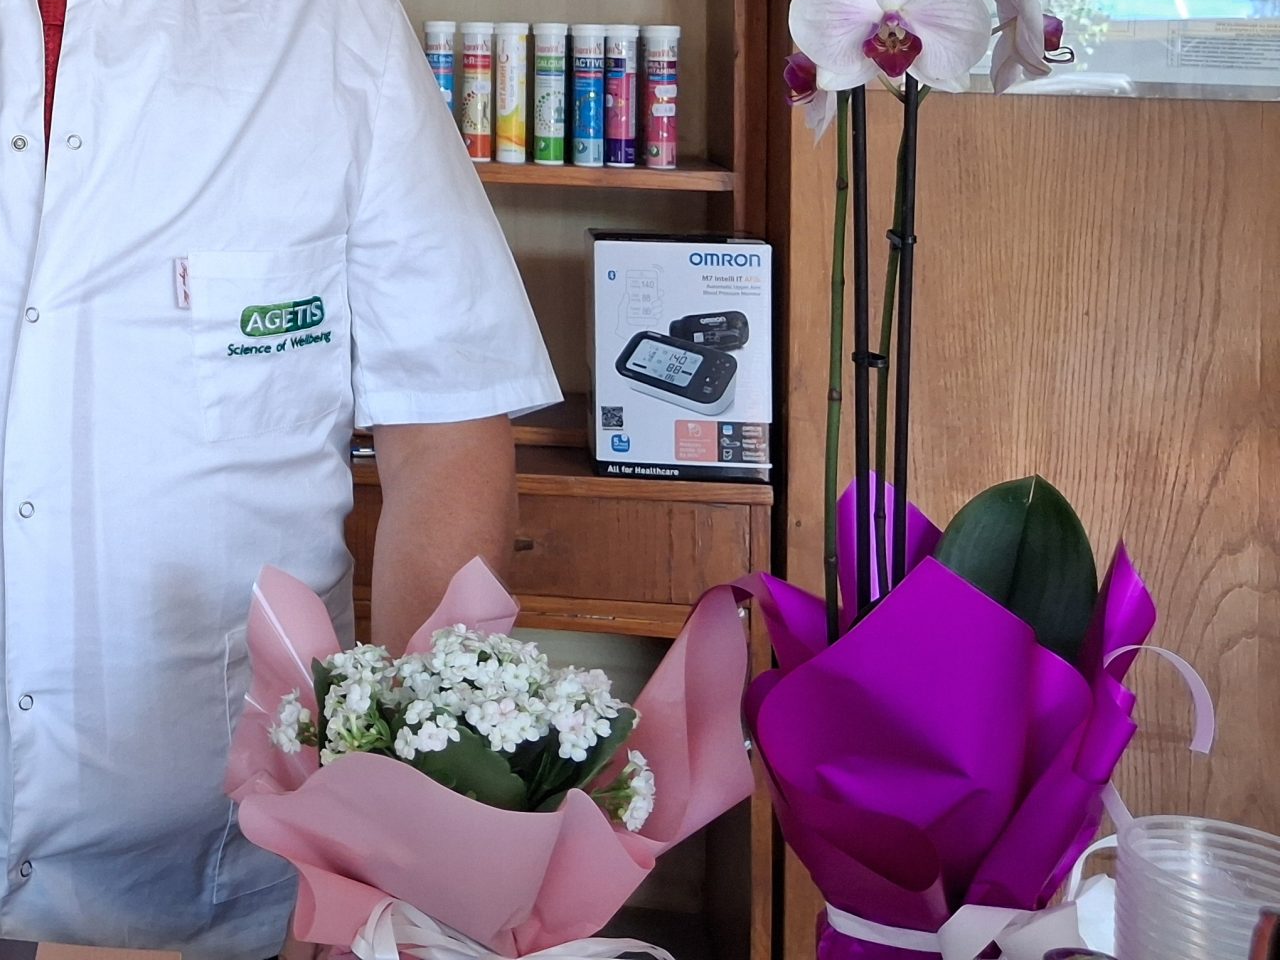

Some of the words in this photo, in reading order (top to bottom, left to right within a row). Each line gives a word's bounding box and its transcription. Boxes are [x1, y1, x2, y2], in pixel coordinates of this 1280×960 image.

[689, 252, 760, 267] OMRON
[246, 301, 322, 332] AGETIS
[227, 344, 272, 356] Science
[276, 339, 287, 352] of
[607, 465, 619, 473] All
[621, 465, 633, 474] for
[634, 466, 679, 476] Healthcare
